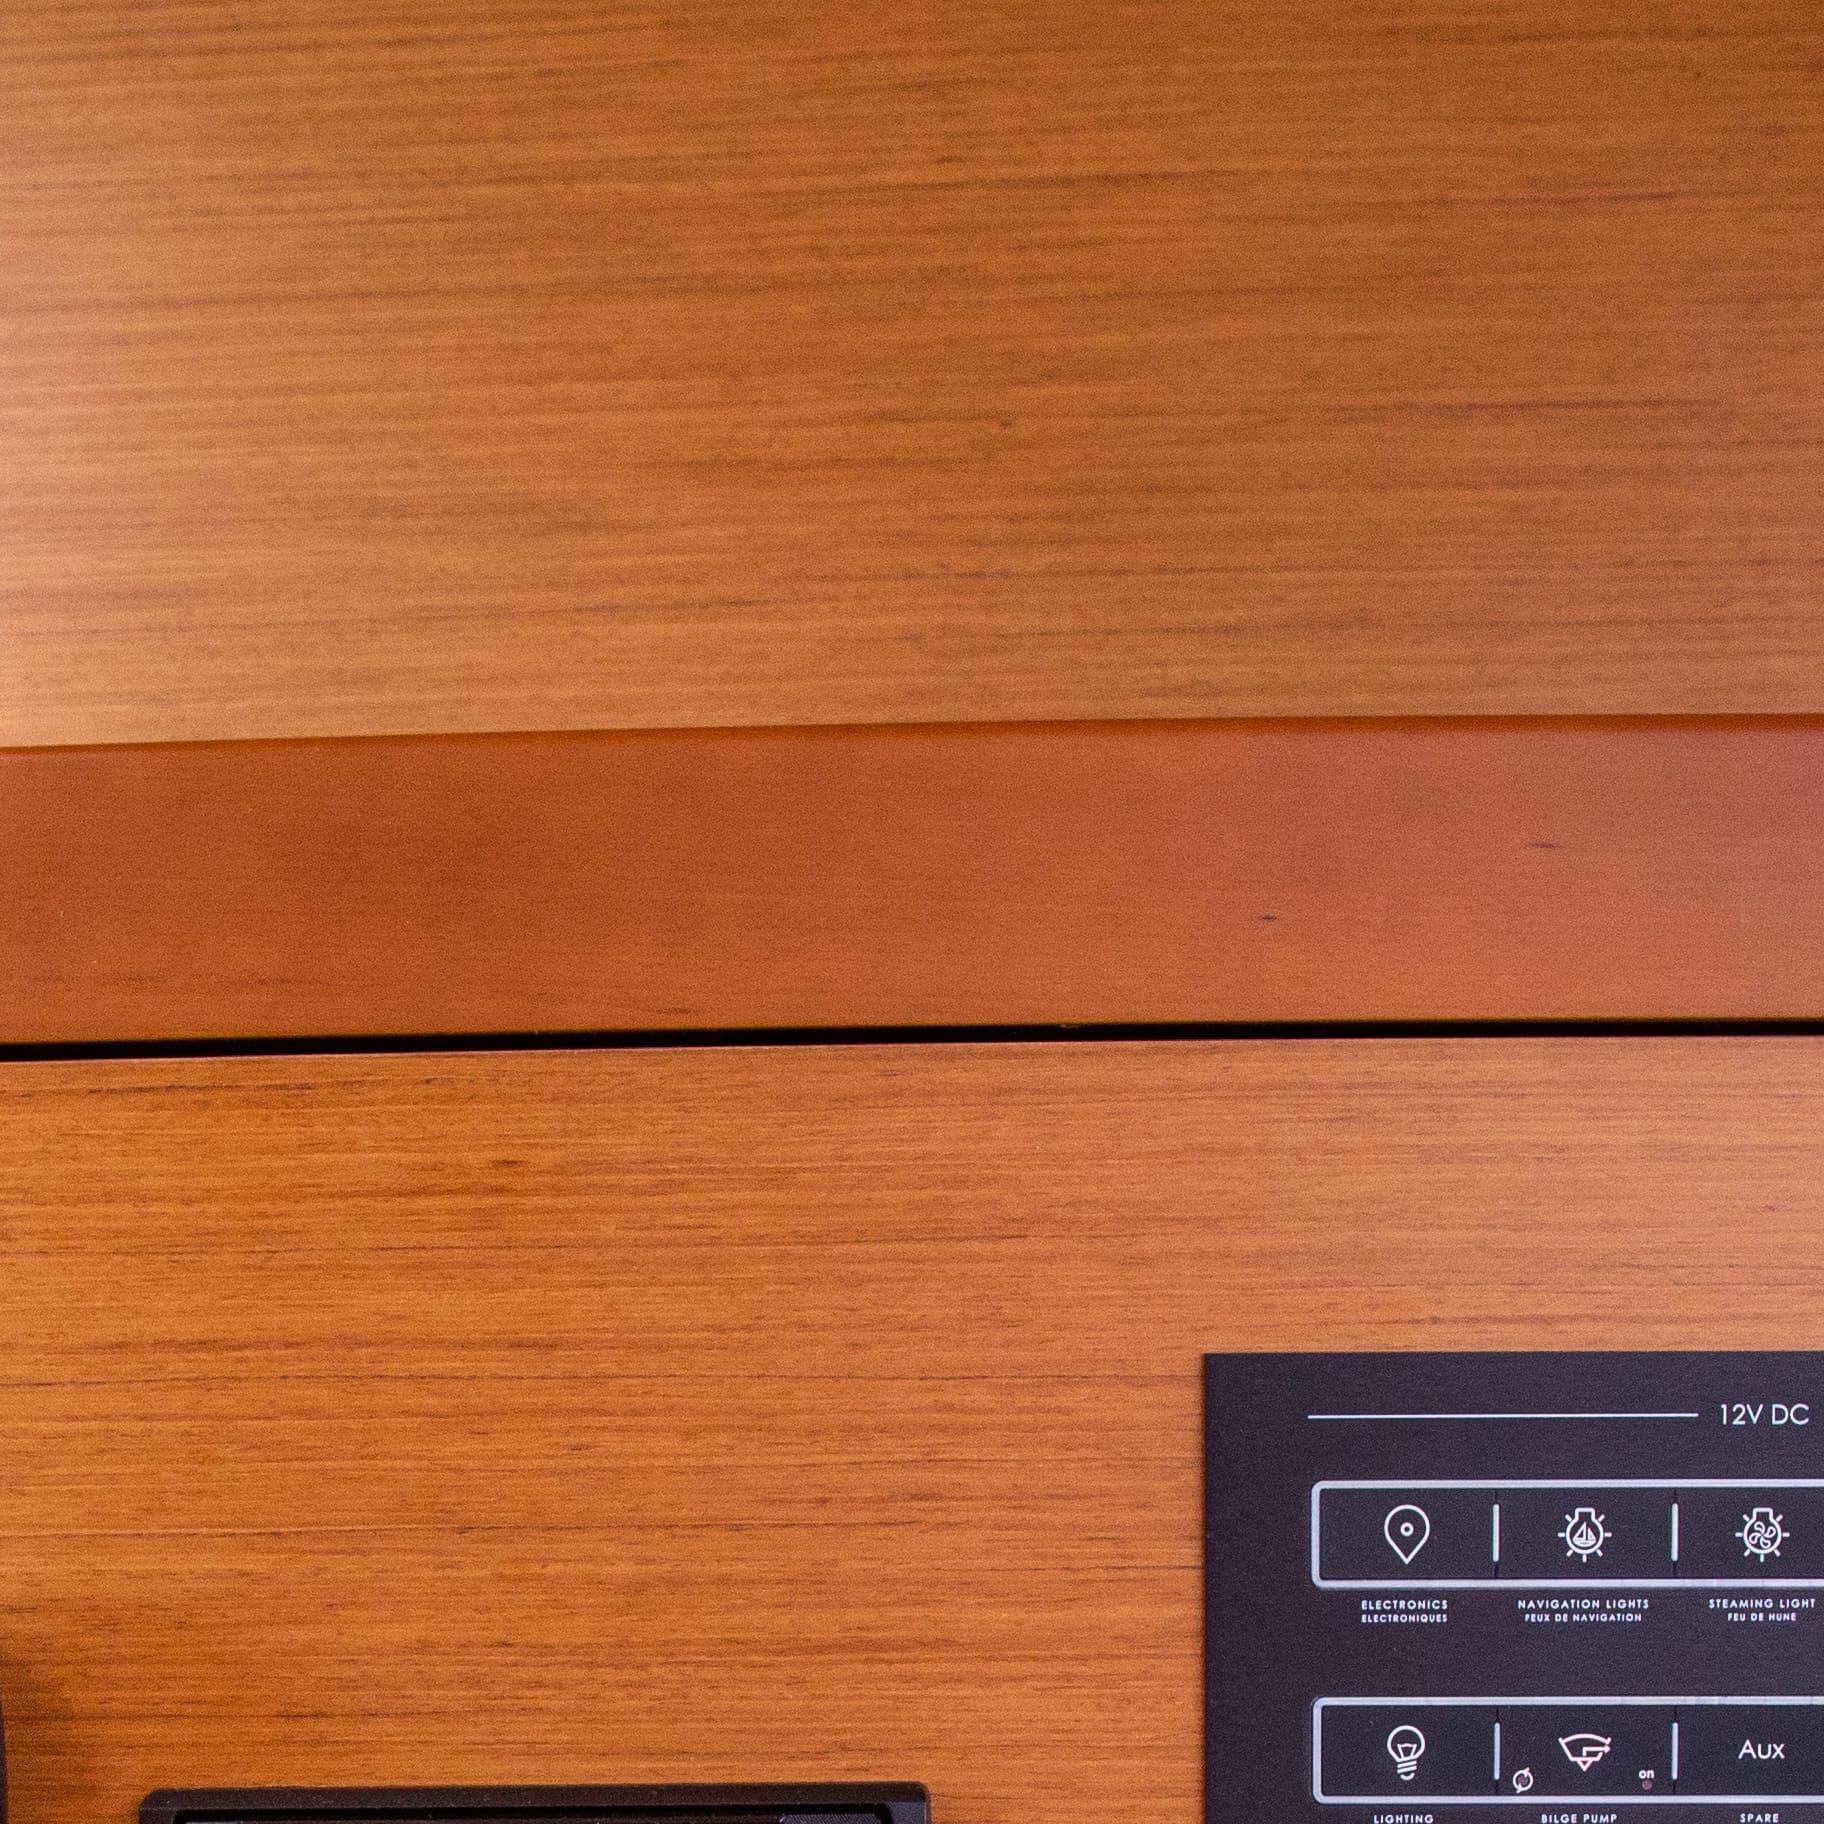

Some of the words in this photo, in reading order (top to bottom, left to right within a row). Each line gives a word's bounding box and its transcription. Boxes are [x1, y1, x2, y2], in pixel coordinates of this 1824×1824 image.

[1721, 1404, 1763, 1425] 12V
[1772, 1404, 1809, 1425] DC
[1362, 1600, 1447, 1610] ELECTRONICS
[1518, 1599, 1599, 1609] NAVIGATION
[1606, 1599, 1648, 1609] LIGHTS
[1709, 1599, 1773, 1608] STEAMING
[1780, 1599, 1815, 1608] LIGHT
[1362, 1614, 1447, 1623] ELECTRONIQUES
[1525, 1614, 1549, 1622] FEUX
[1555, 1614, 1568, 1622] DE
[1573, 1613, 1641, 1622] NAVIGATION
[1728, 1613, 1745, 1621] FEU
[1751, 1613, 1763, 1621] DE
[1769, 1613, 1796, 1621] HUNE
[1739, 1740, 1784, 1759] Aux
[1639, 1770, 1654, 1779] on
[1374, 1814, 1433, 1824] LIGHTING
[1542, 1814, 1576, 1823] BILGE
[1583, 1814, 1617, 1823] PUMP
[1741, 1813, 1778, 1823] SPARE
